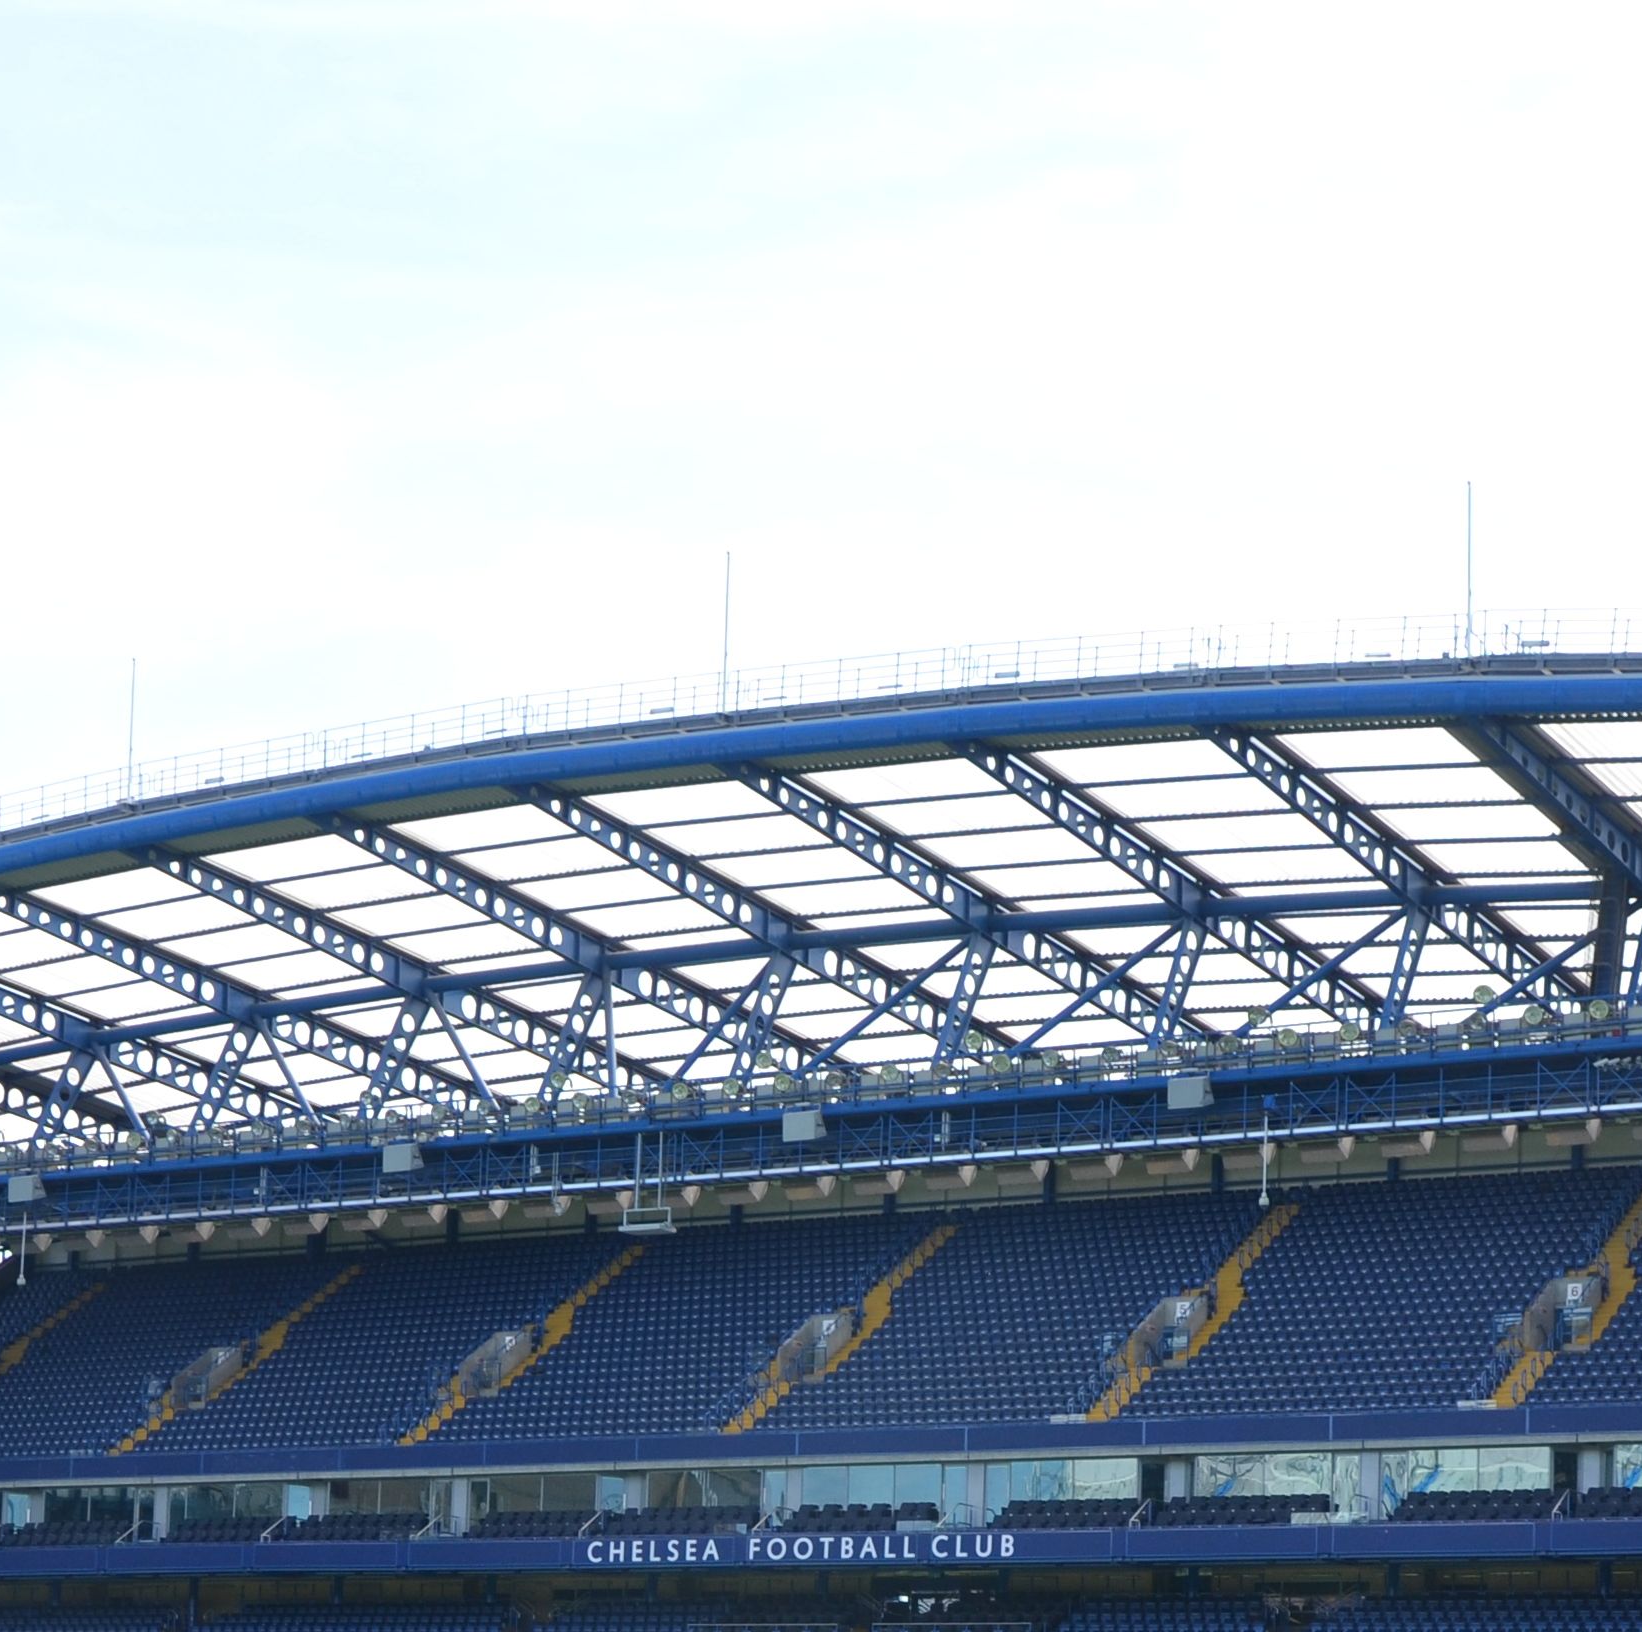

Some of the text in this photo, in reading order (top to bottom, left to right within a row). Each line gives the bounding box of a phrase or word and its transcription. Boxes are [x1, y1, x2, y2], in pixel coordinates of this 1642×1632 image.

[587, 1534, 1015, 1563] CHELSEA FOOTBALL CLUB
